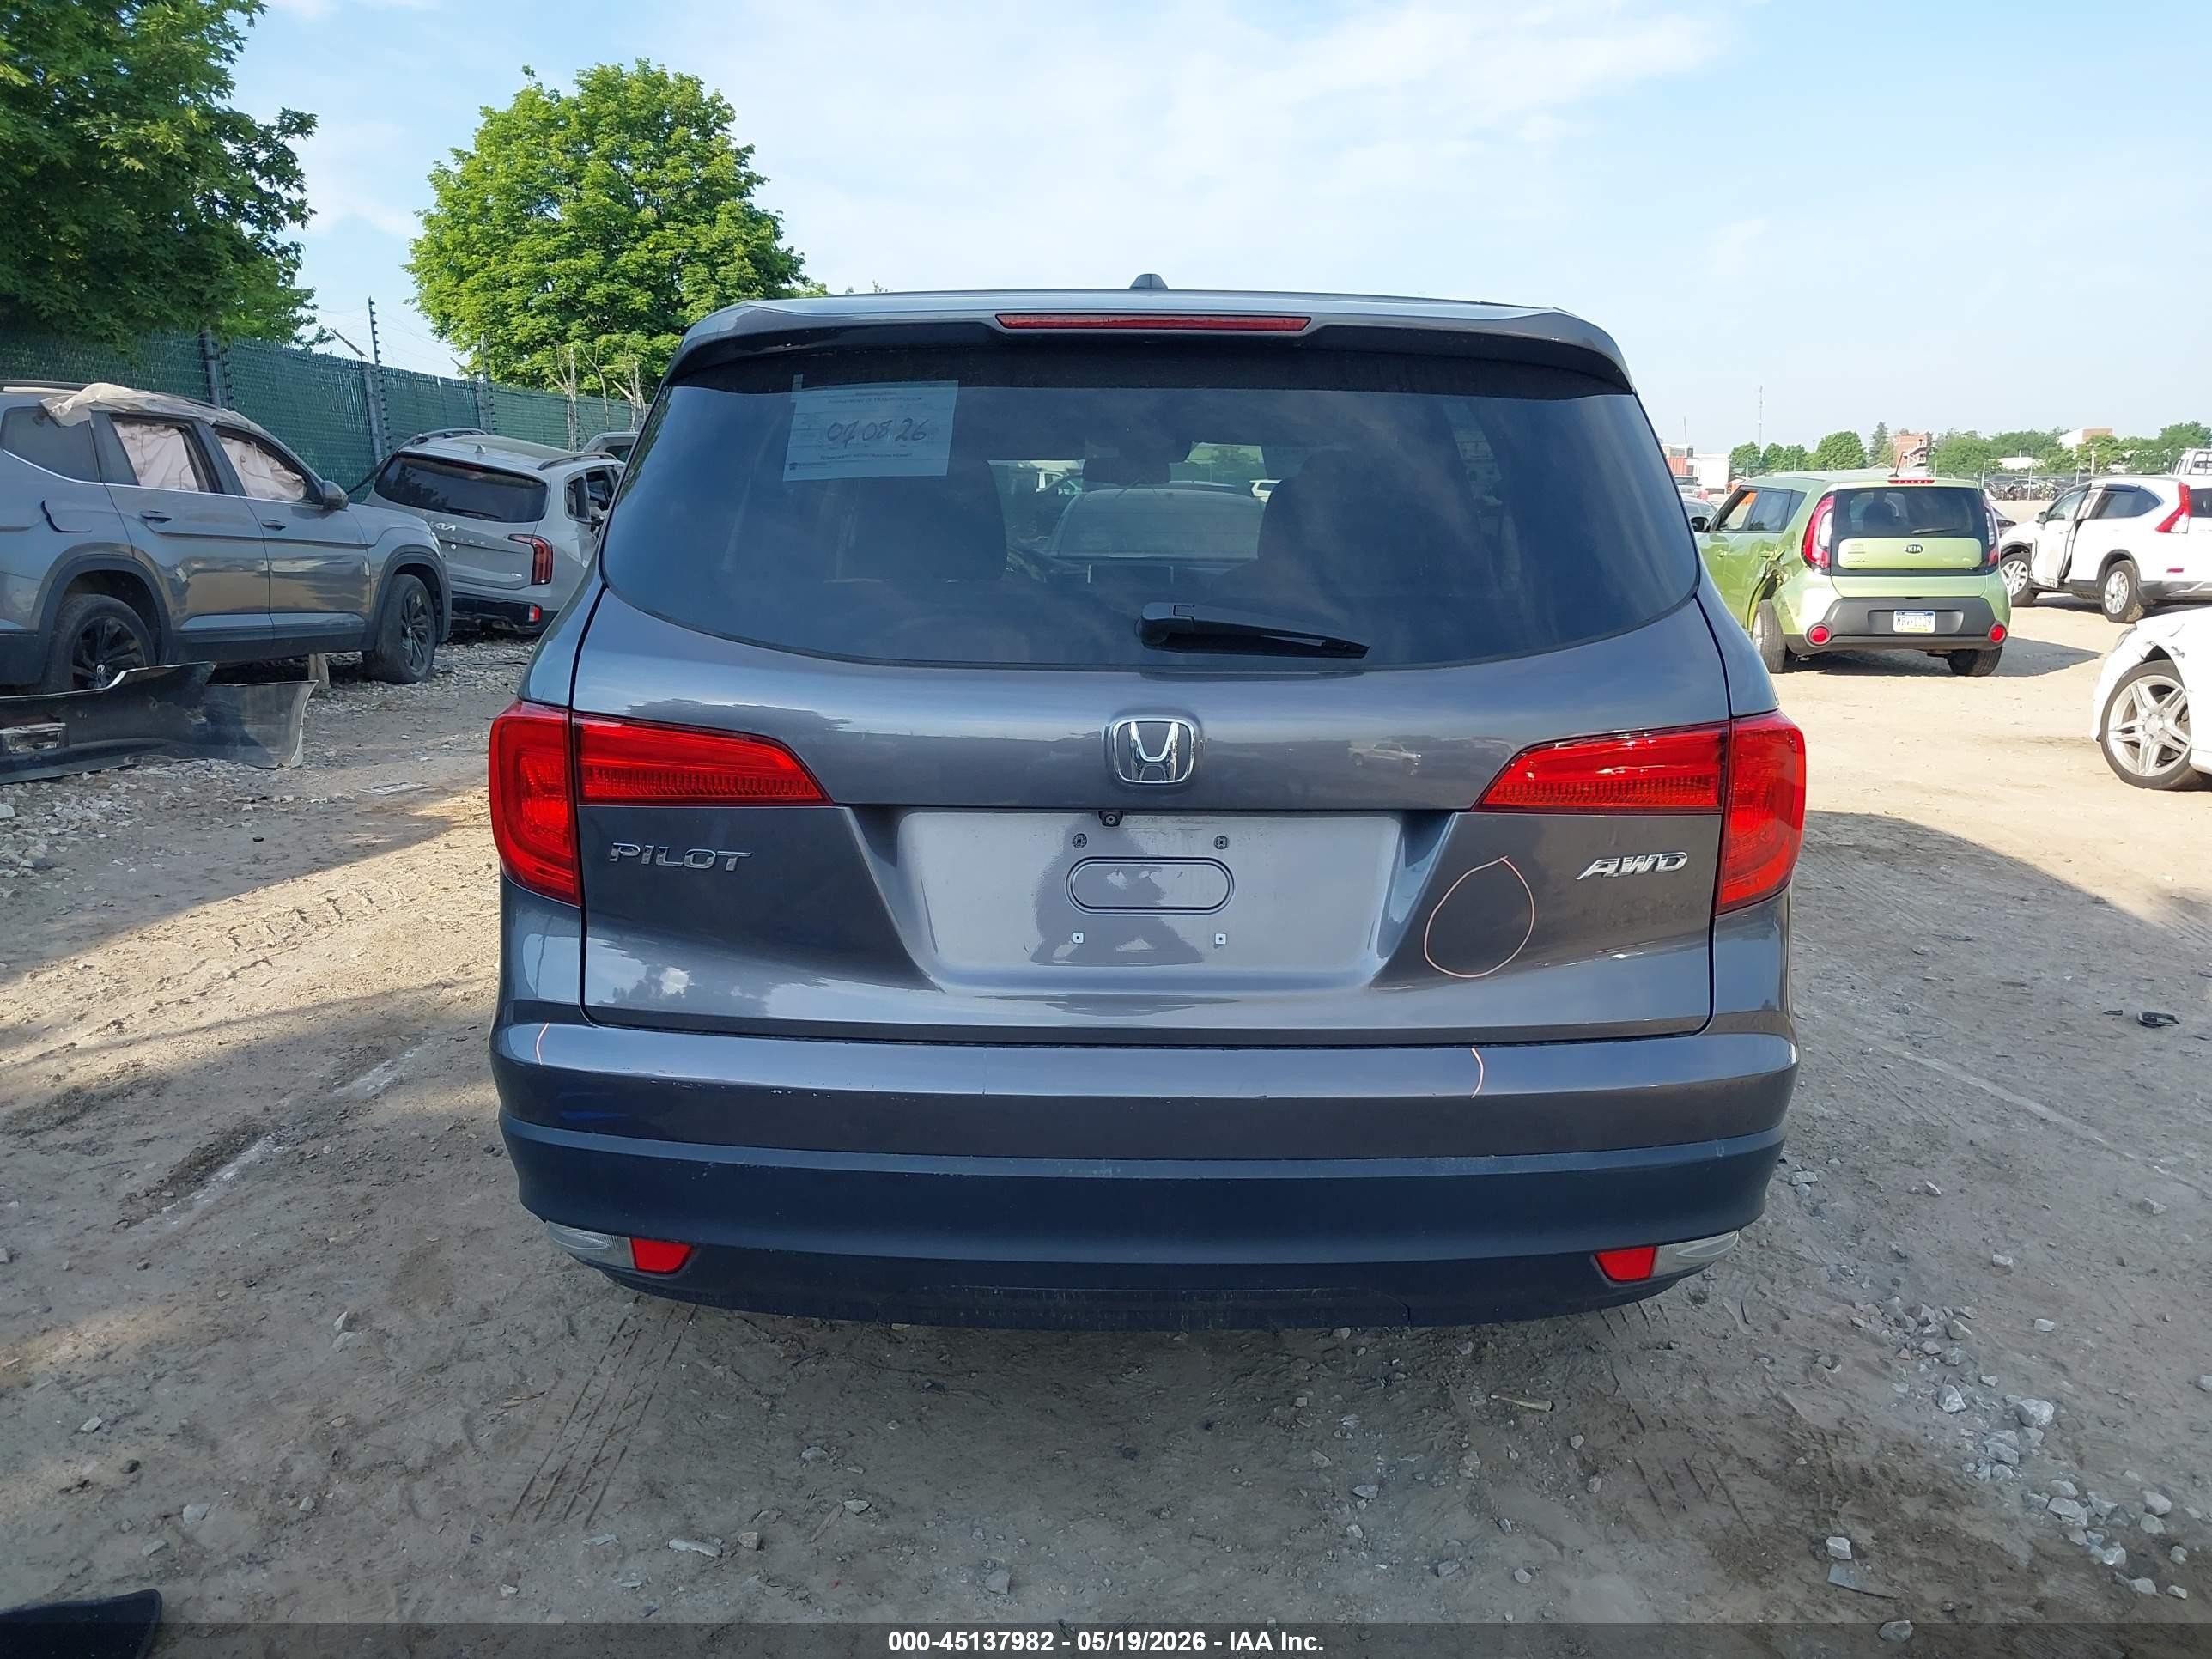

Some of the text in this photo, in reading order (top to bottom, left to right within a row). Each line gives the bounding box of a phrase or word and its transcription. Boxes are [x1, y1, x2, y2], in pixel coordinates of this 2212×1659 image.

[862, 419, 892, 441] 08
[895, 417, 928, 441] 26
[1907, 545, 1923, 554] KIA
[609, 842, 752, 872] PILOT
[1575, 851, 1688, 880] AWD
